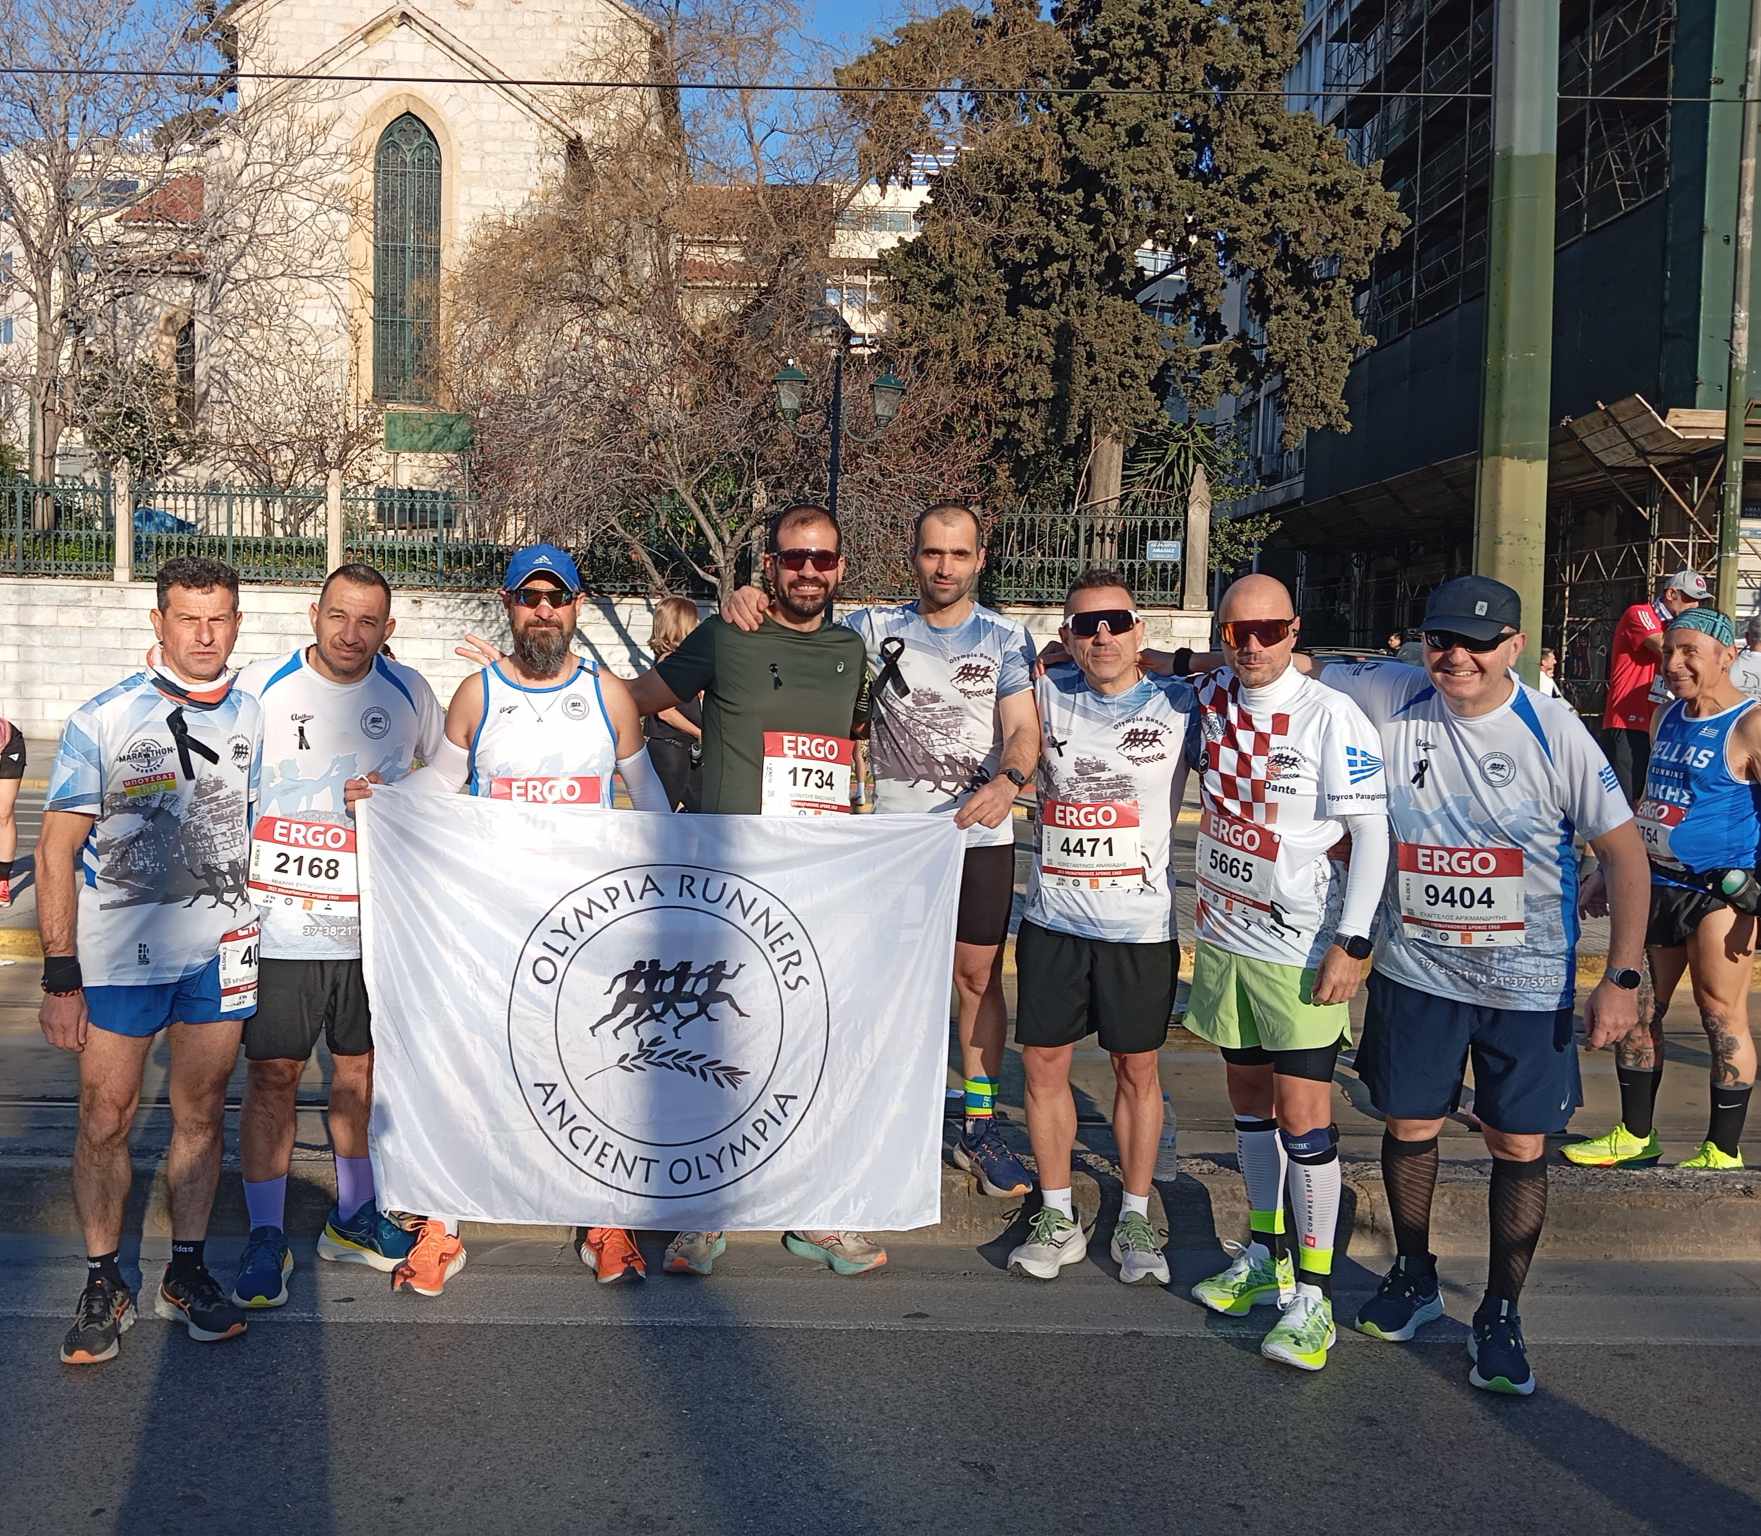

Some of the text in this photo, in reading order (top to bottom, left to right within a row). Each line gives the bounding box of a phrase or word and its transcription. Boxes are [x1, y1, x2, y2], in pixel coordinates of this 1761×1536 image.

[783, 736, 838, 760] ERGO
[788, 767, 835, 790] 1734
[1264, 780, 1297, 795] Dante
[511, 780, 582, 802] ERGO
[1327, 793, 1354, 802] Spyros
[1055, 805, 1117, 827] ERGO
[1637, 801, 1669, 820] ERGO
[273, 820, 346, 849] ERGO
[1210, 816, 1261, 851] ERGO
[1060, 837, 1114, 857] 4471
[274, 852, 340, 880] 2168
[1209, 848, 1254, 883] 5665
[1417, 848, 1497, 875] ERGO
[1424, 884, 1495, 909] 9404
[532, 874, 809, 992] OLYMPIA RUNNERS
[534, 1083, 798, 1185] ANCIENT OLYMPIA
